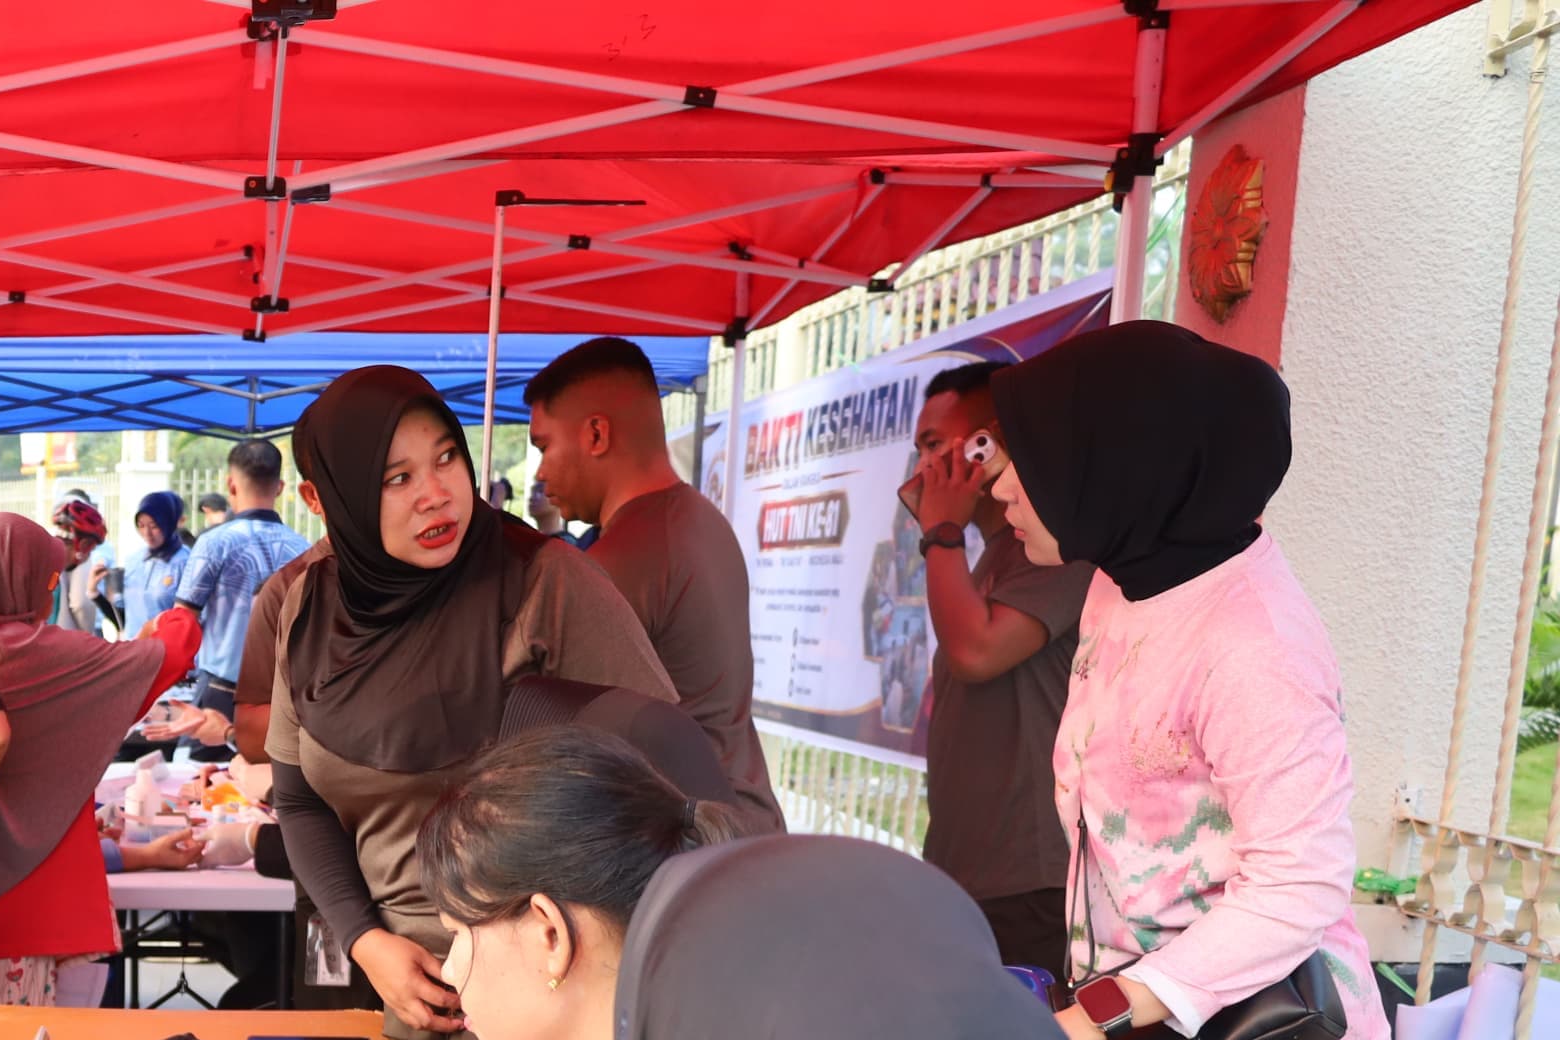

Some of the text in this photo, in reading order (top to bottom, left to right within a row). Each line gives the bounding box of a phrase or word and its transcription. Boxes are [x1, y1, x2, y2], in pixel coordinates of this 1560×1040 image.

[744, 376, 918, 477] BAKTI KESEHATAN
[762, 506, 787, 544] HUT
[786, 502, 809, 541] TNI
